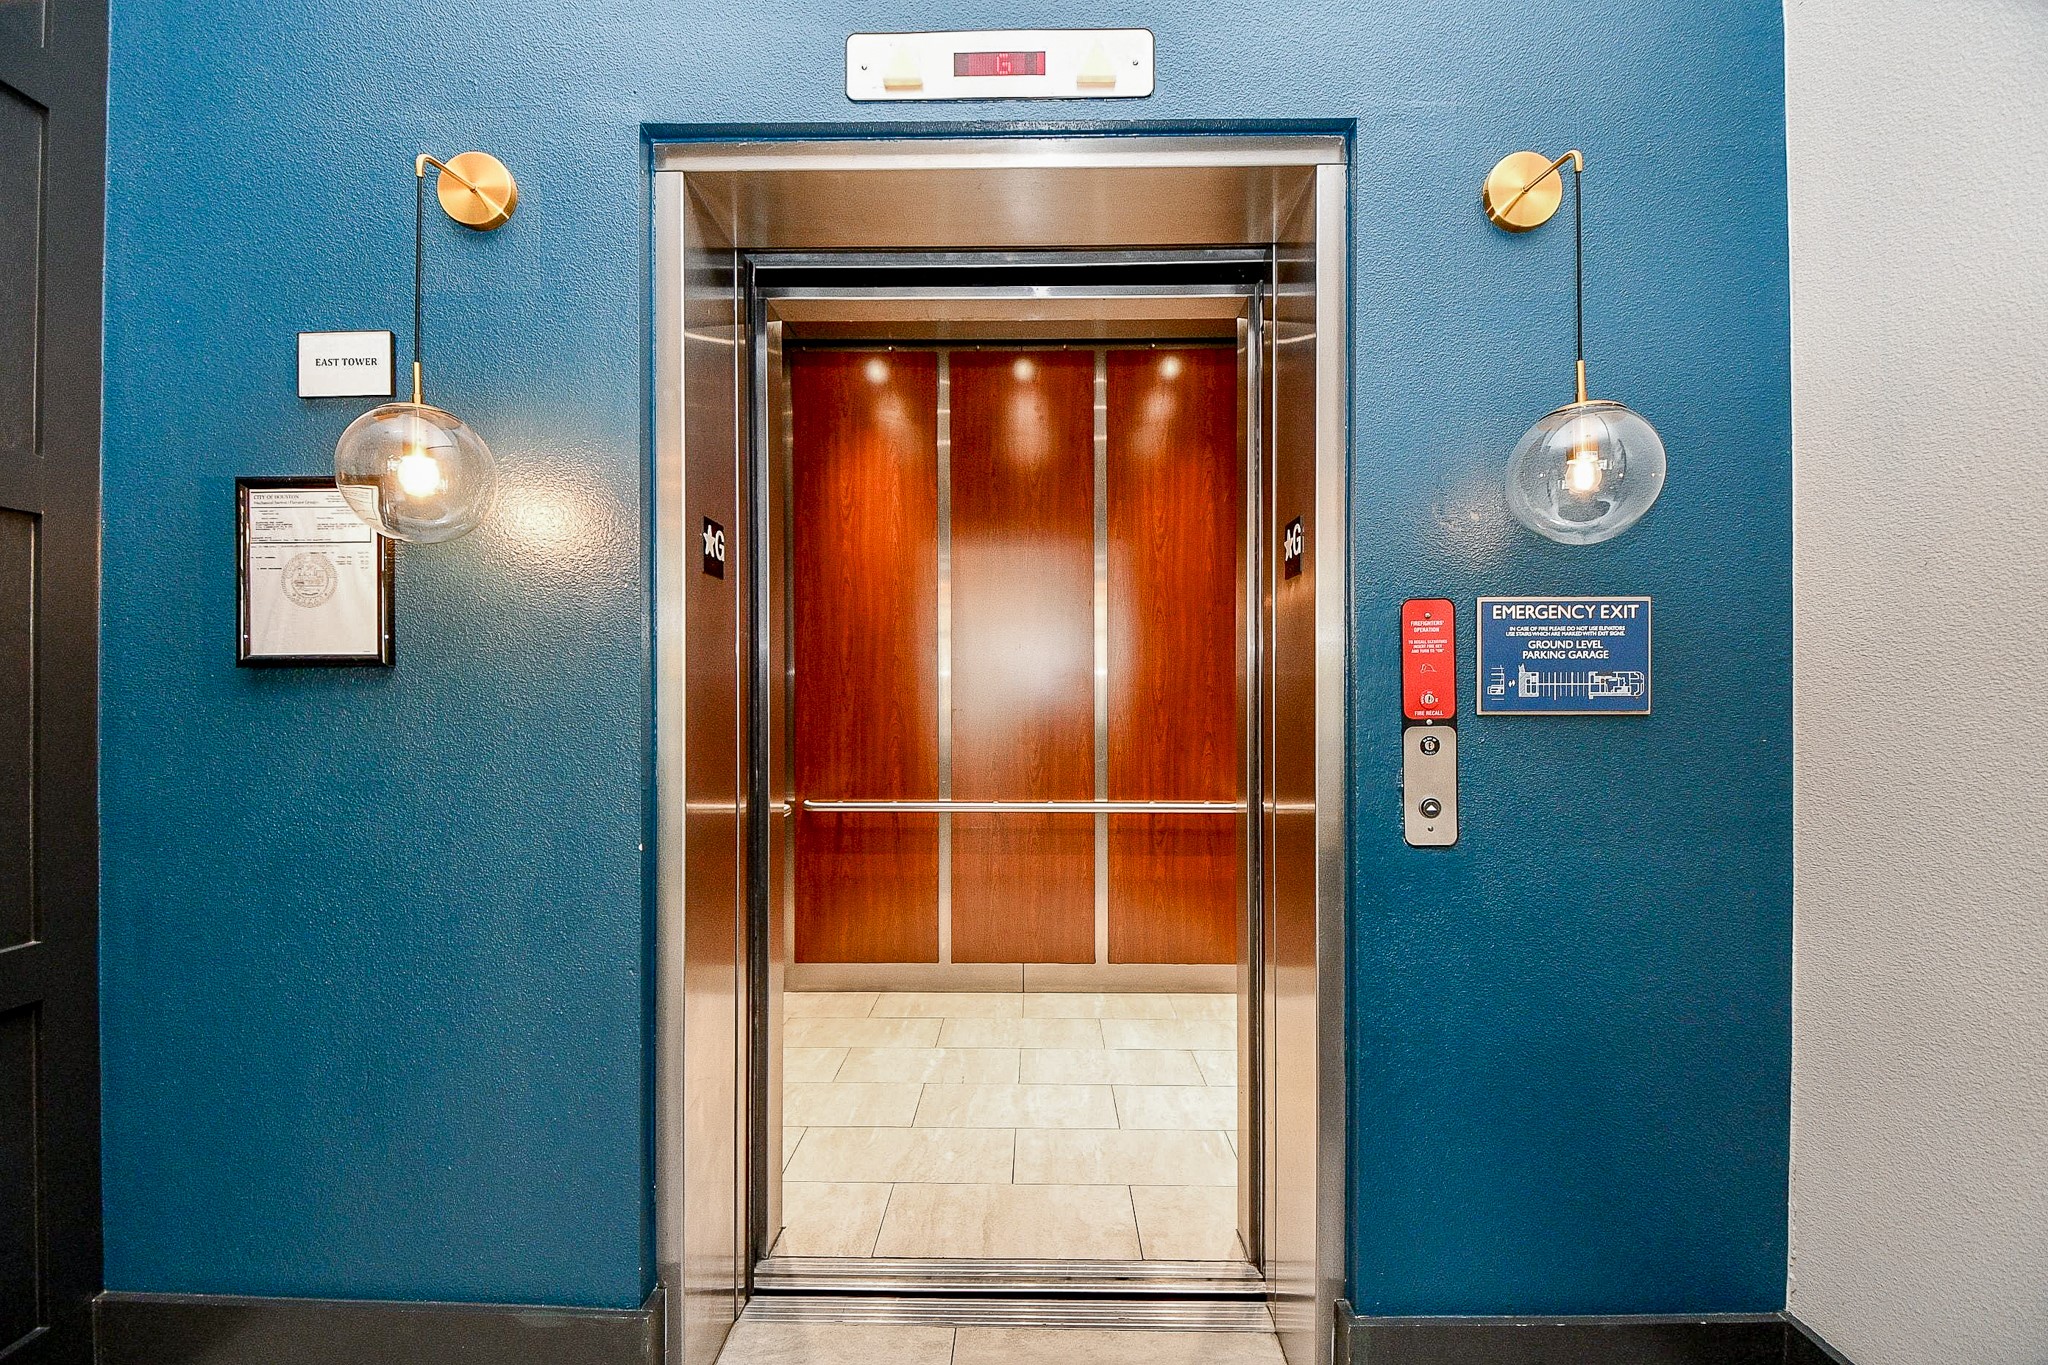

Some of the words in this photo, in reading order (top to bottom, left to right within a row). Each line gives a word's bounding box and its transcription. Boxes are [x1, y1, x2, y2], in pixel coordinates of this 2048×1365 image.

[996, 53, 1011, 75] G
[315, 358, 339, 366] EAST
[341, 357, 377, 366] TOWER
[715, 530, 725, 561] G
[1293, 523, 1301, 555] G
[1493, 605, 1596, 619] EMERGENCY
[1600, 605, 1639, 619] EXIT
[1528, 640, 1573, 649] GROUND
[1576, 640, 1603, 649] LEVEL
[1523, 650, 1565, 660] PARKING
[1568, 650, 1610, 659] GARAGE
